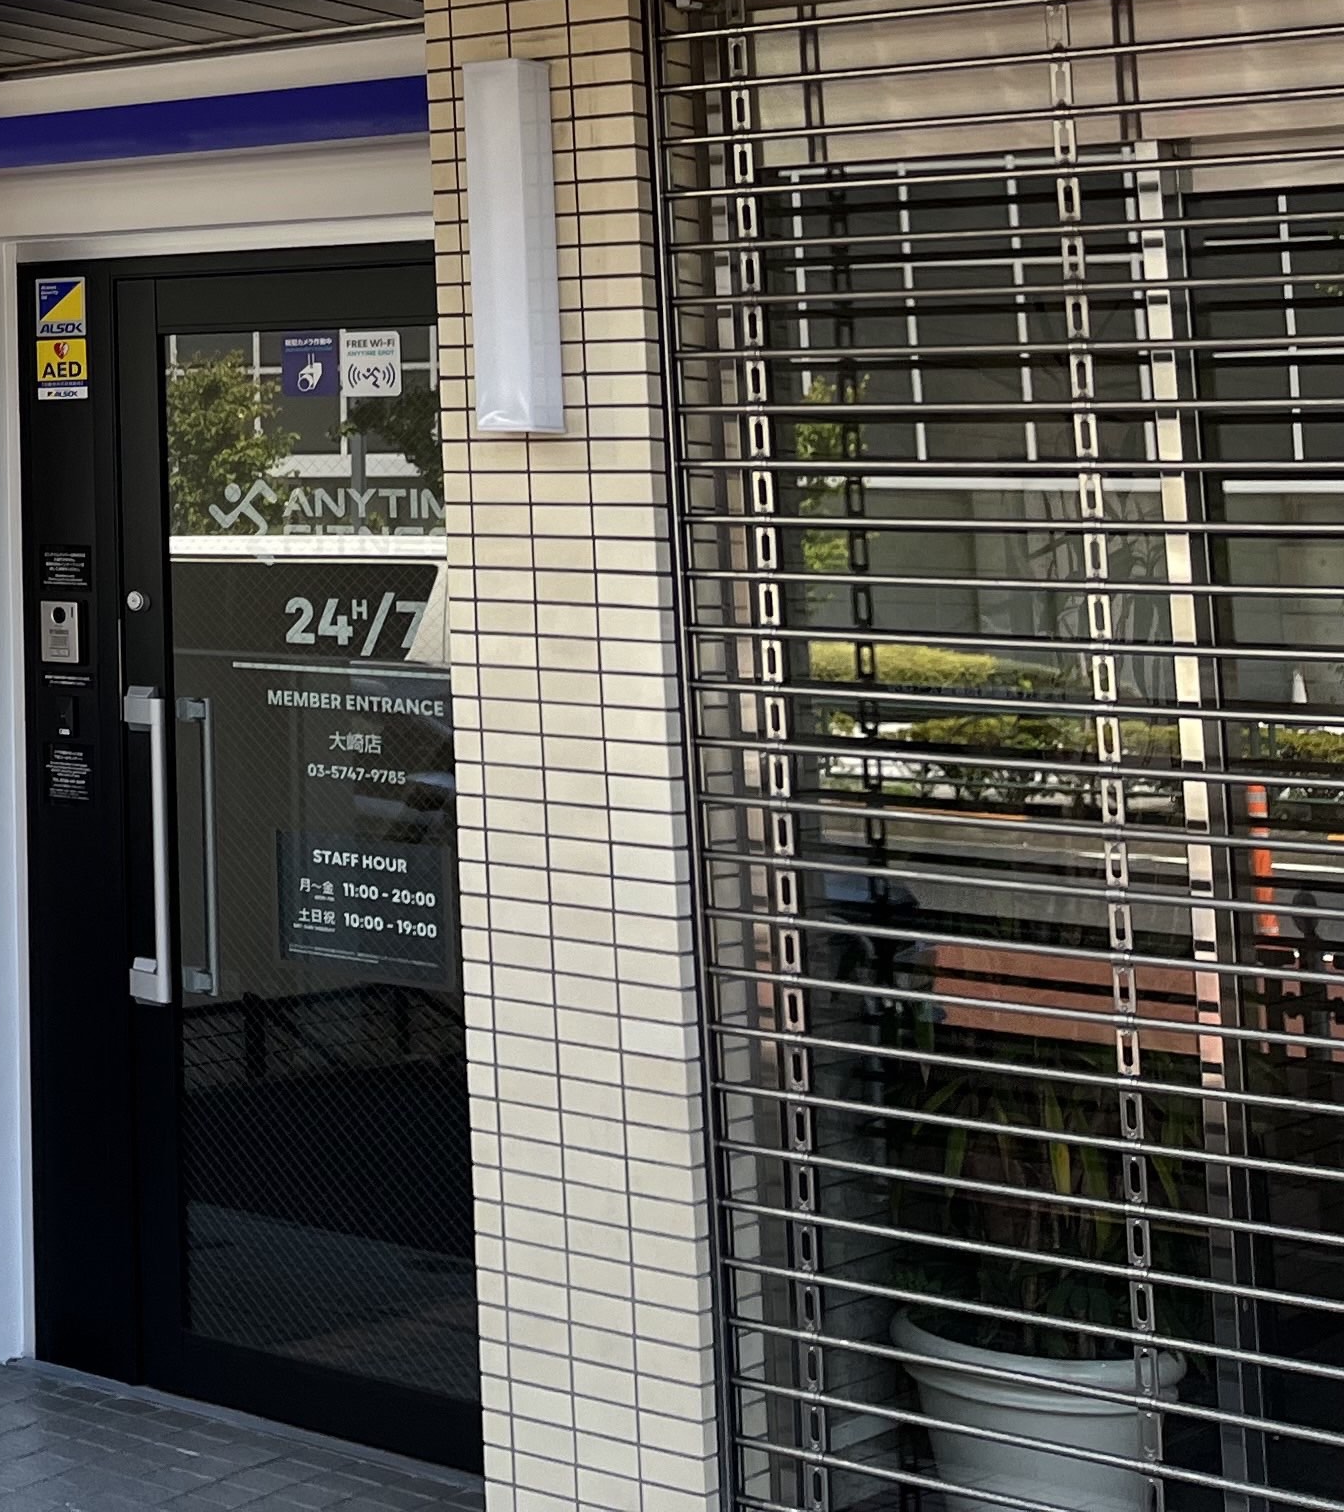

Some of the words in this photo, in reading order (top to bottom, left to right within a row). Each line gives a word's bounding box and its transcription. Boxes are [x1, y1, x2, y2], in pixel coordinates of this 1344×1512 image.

[40, 322, 82, 334] ALSOK
[346, 339, 367, 348] FREE
[370, 338, 395, 348] Wi-Fi
[42, 361, 82, 379] AED
[267, 689, 341, 710] MEMBER
[346, 694, 444, 716] ENTRANCE
[329, 731, 382, 755] 大崎店
[307, 763, 406, 785] 03-5747-9785
[313, 849, 359, 868] STAFF
[362, 854, 407, 873] HOUR
[342, 882, 378, 900] 11:00
[392, 888, 436, 907] 20:00
[298, 907, 335, 925] 土日祝
[343, 912, 384, 931] 10:00
[397, 919, 437, 938] 19:00
